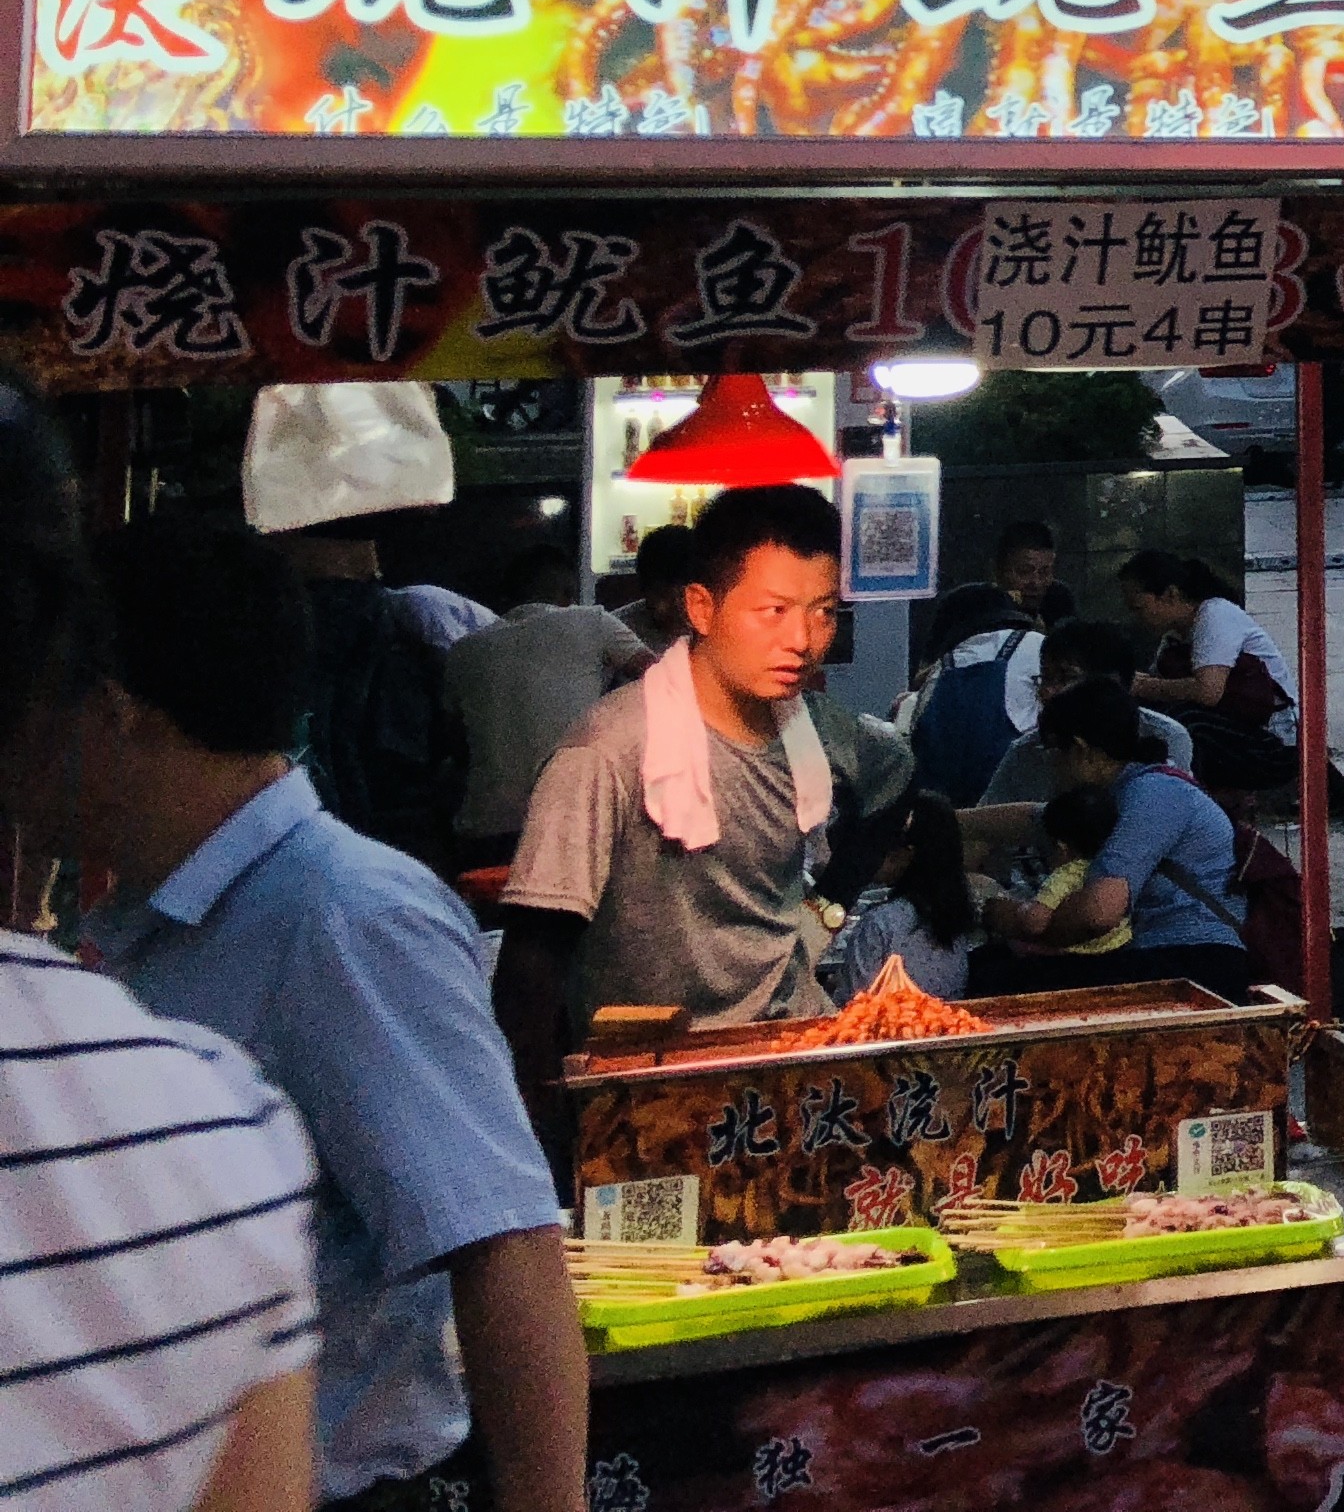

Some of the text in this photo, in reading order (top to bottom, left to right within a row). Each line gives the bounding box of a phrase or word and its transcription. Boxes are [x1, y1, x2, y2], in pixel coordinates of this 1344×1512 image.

[984, 210, 1267, 288] 浇汁鱿鱼
[61, 215, 816, 362] 烧汁鱿鱼
[980, 297, 1255, 360] 10元4串
